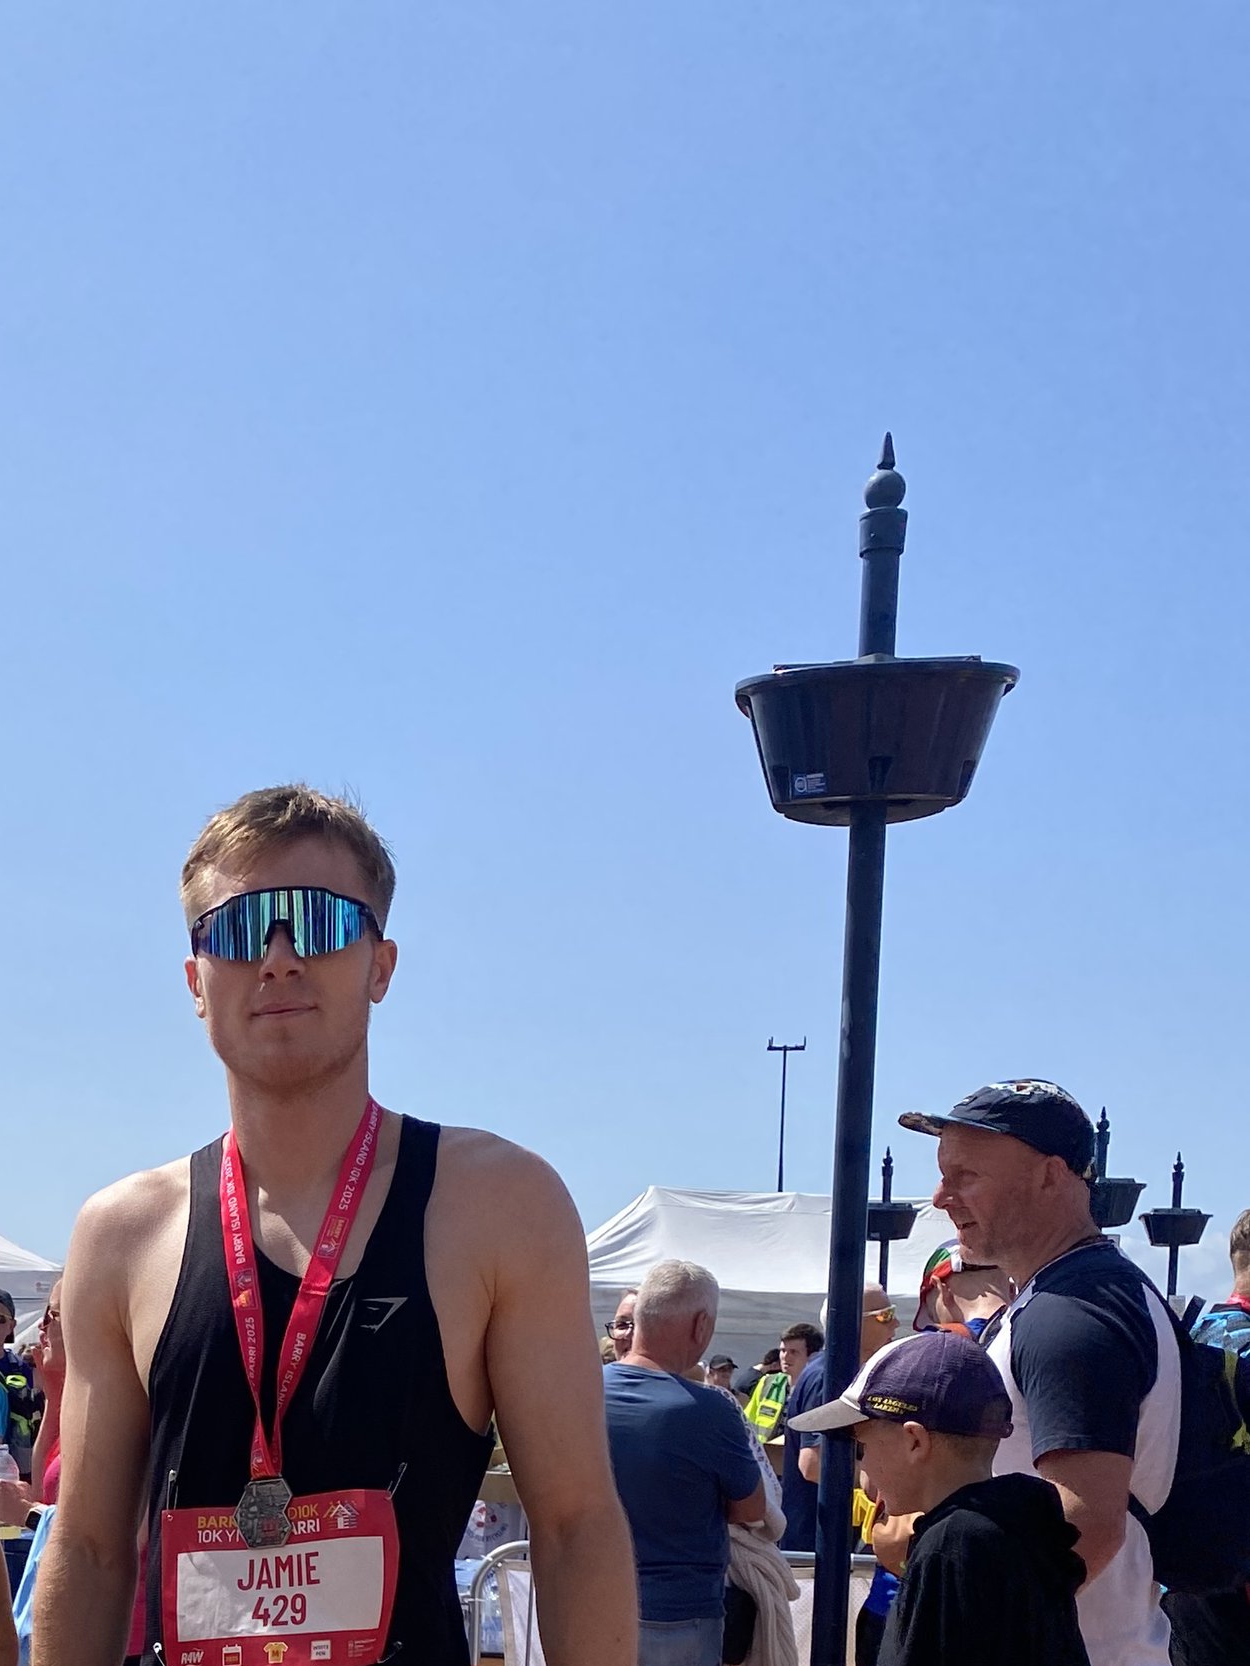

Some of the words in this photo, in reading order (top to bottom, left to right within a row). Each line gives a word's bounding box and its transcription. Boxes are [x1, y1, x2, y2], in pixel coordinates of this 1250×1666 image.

[356, 1131, 374, 1166] ISLAND
[350, 1166, 362, 1183] 10K
[338, 1184, 355, 1210] 2025
[228, 1197, 241, 1231] ISLAND
[233, 1233, 246, 1265] BARRY
[244, 1316, 255, 1344] 2025
[289, 1332, 307, 1370] BARRY
[197, 1530, 223, 1543] 10K
[237, 1551, 320, 1591] JAMIE
[251, 1593, 307, 1627] 429
